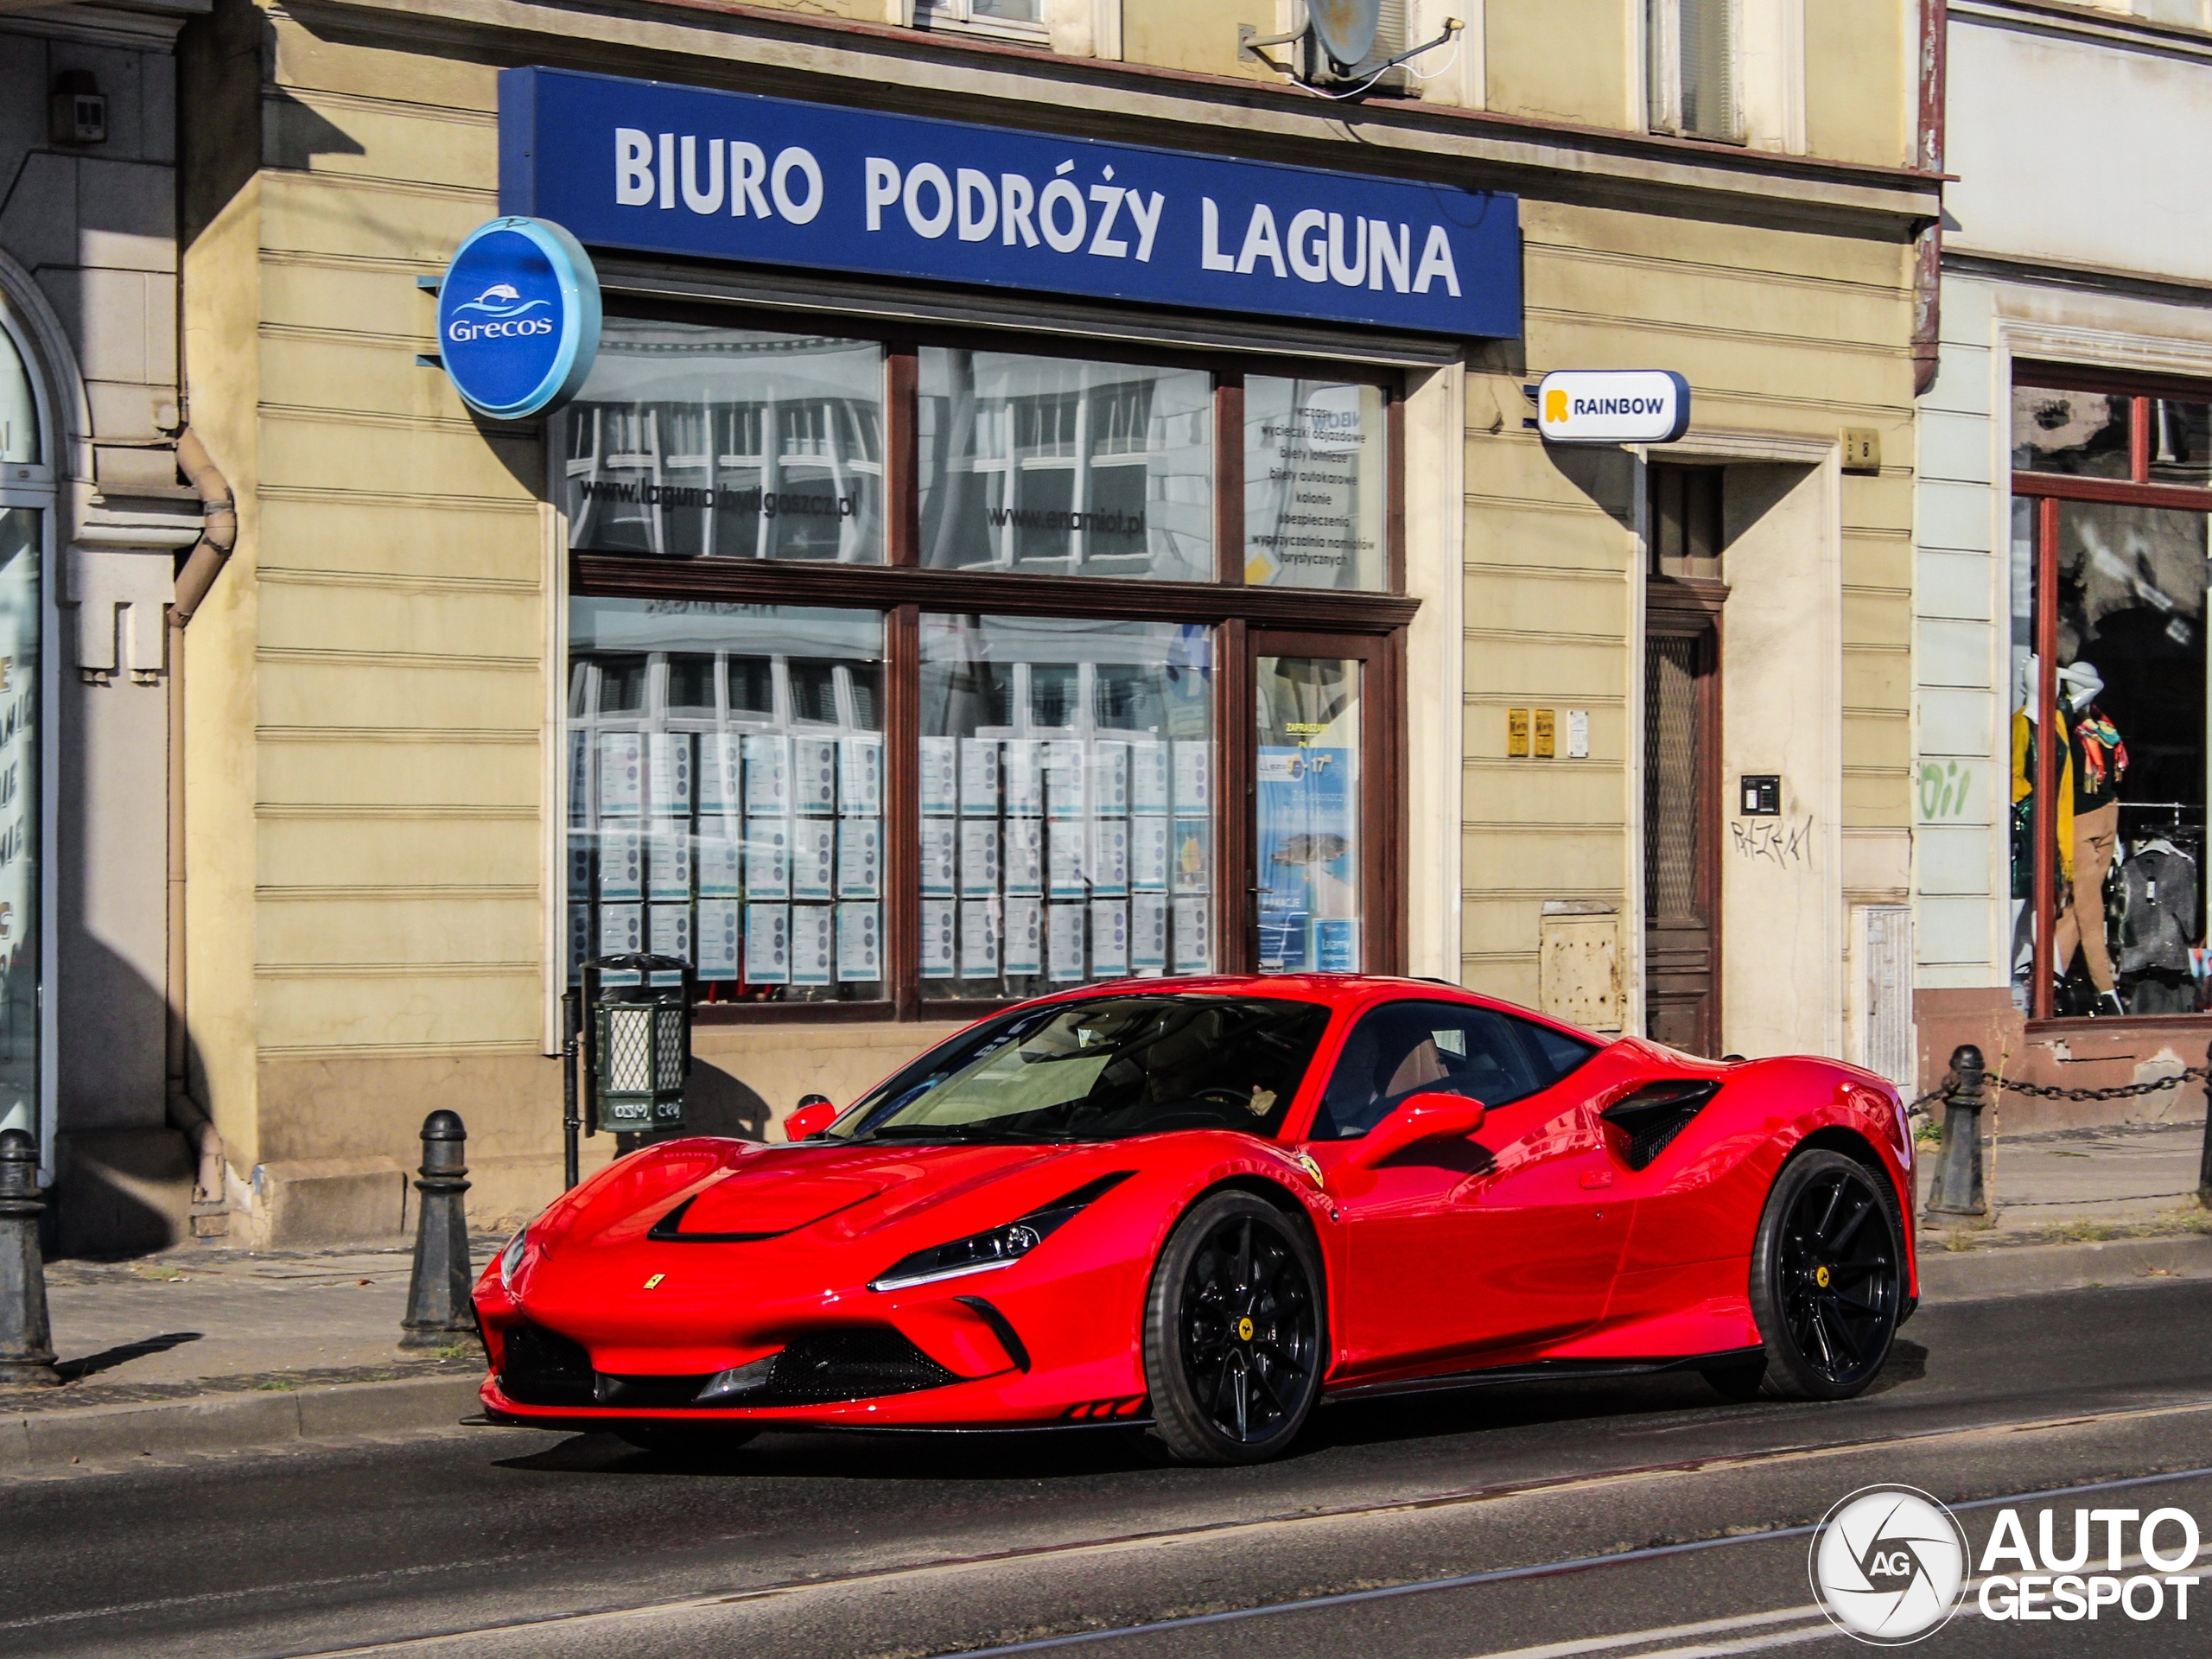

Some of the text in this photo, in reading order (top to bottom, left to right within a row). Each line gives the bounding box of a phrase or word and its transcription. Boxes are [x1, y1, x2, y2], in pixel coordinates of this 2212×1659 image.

[615, 127, 1462, 298] BIURO PODRÓŻY LAGUNA
[448, 317, 553, 342] Grecos
[1574, 397, 1664, 415] RAINBOW
[1262, 424, 1366, 443] wycieczki objazdowe
[1280, 446, 1306, 461] bilety
[1270, 467, 1357, 486] bilety autokarowe
[1296, 492, 1332, 505] kolonie
[1279, 512, 1350, 528] ubezpieczenia
[1252, 534, 1375, 550] wypożyczalnia namiotów
[1279, 552, 1348, 568] turystycznych
